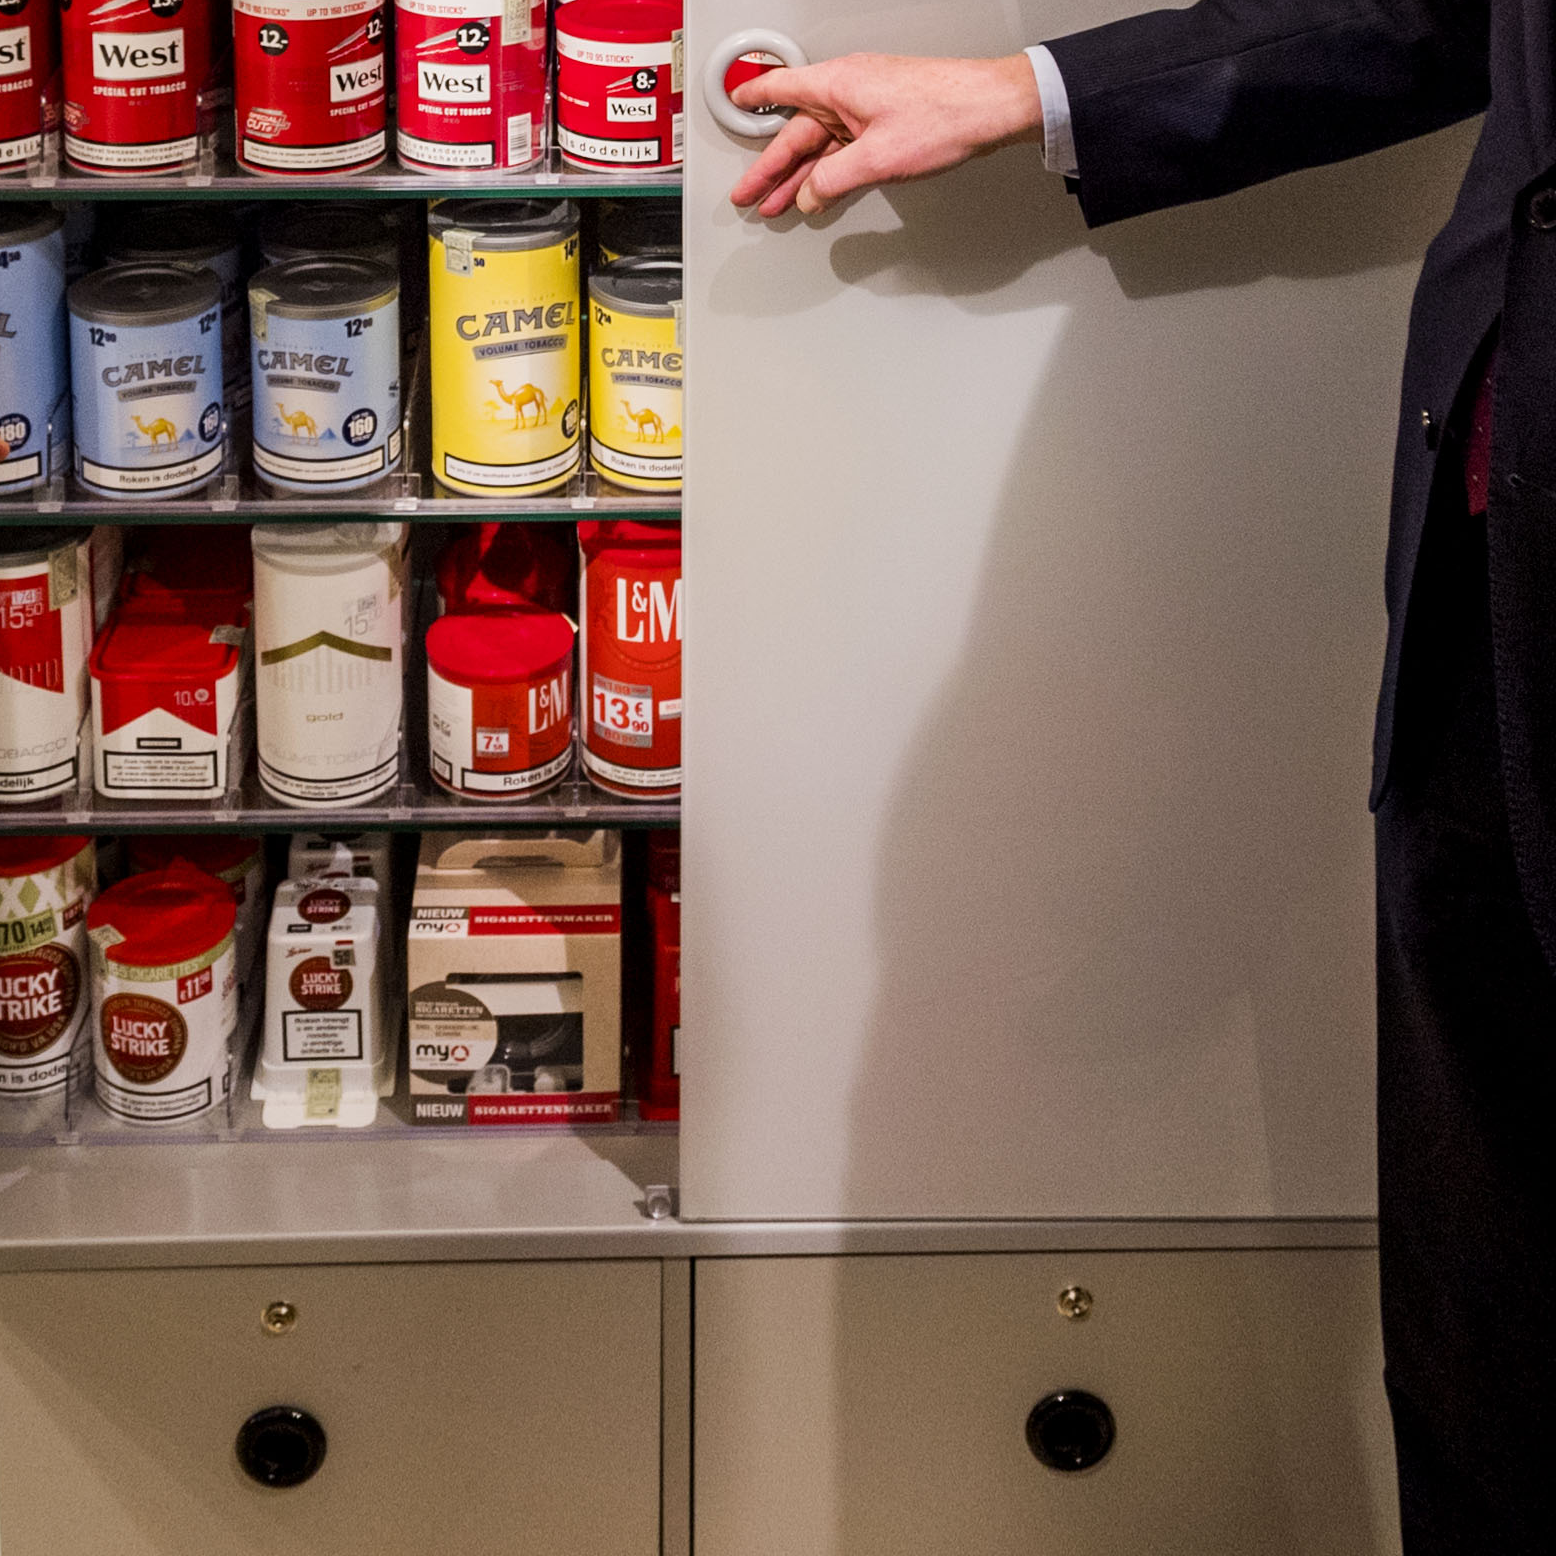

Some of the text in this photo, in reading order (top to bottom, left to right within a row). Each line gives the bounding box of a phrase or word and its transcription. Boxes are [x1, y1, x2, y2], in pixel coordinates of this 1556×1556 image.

[99, 39, 179, 69] West
[336, 64, 383, 92] West
[423, 71, 485, 94] West
[93, 81, 187, 97] SPECIAL CUT TOBACCO
[611, 102, 653, 116] West
[455, 301, 576, 341] CAMEL
[479, 337, 565, 357] VOLUME TOBACCO
[101, 355, 206, 388] CAMEL
[257, 349, 354, 377] CAMEL
[347, 419, 373, 437] 160
[617, 577, 682, 643] L&M
[528, 670, 569, 735] L&M
[306, 711, 344, 723] gold
[416, 908, 465, 919] NIEUW
[474, 914, 614, 924] SIGARETTENMAKER
[300, 982, 342, 995] STRIKE
[302, 973, 341, 985] LUCKY
[112, 1015, 168, 1039] LUCKY
[111, 1034, 170, 1057] STRIKE
[416, 1103, 464, 1118] NIEUW
[474, 1104, 612, 1117] SIGARETTENMAKER
